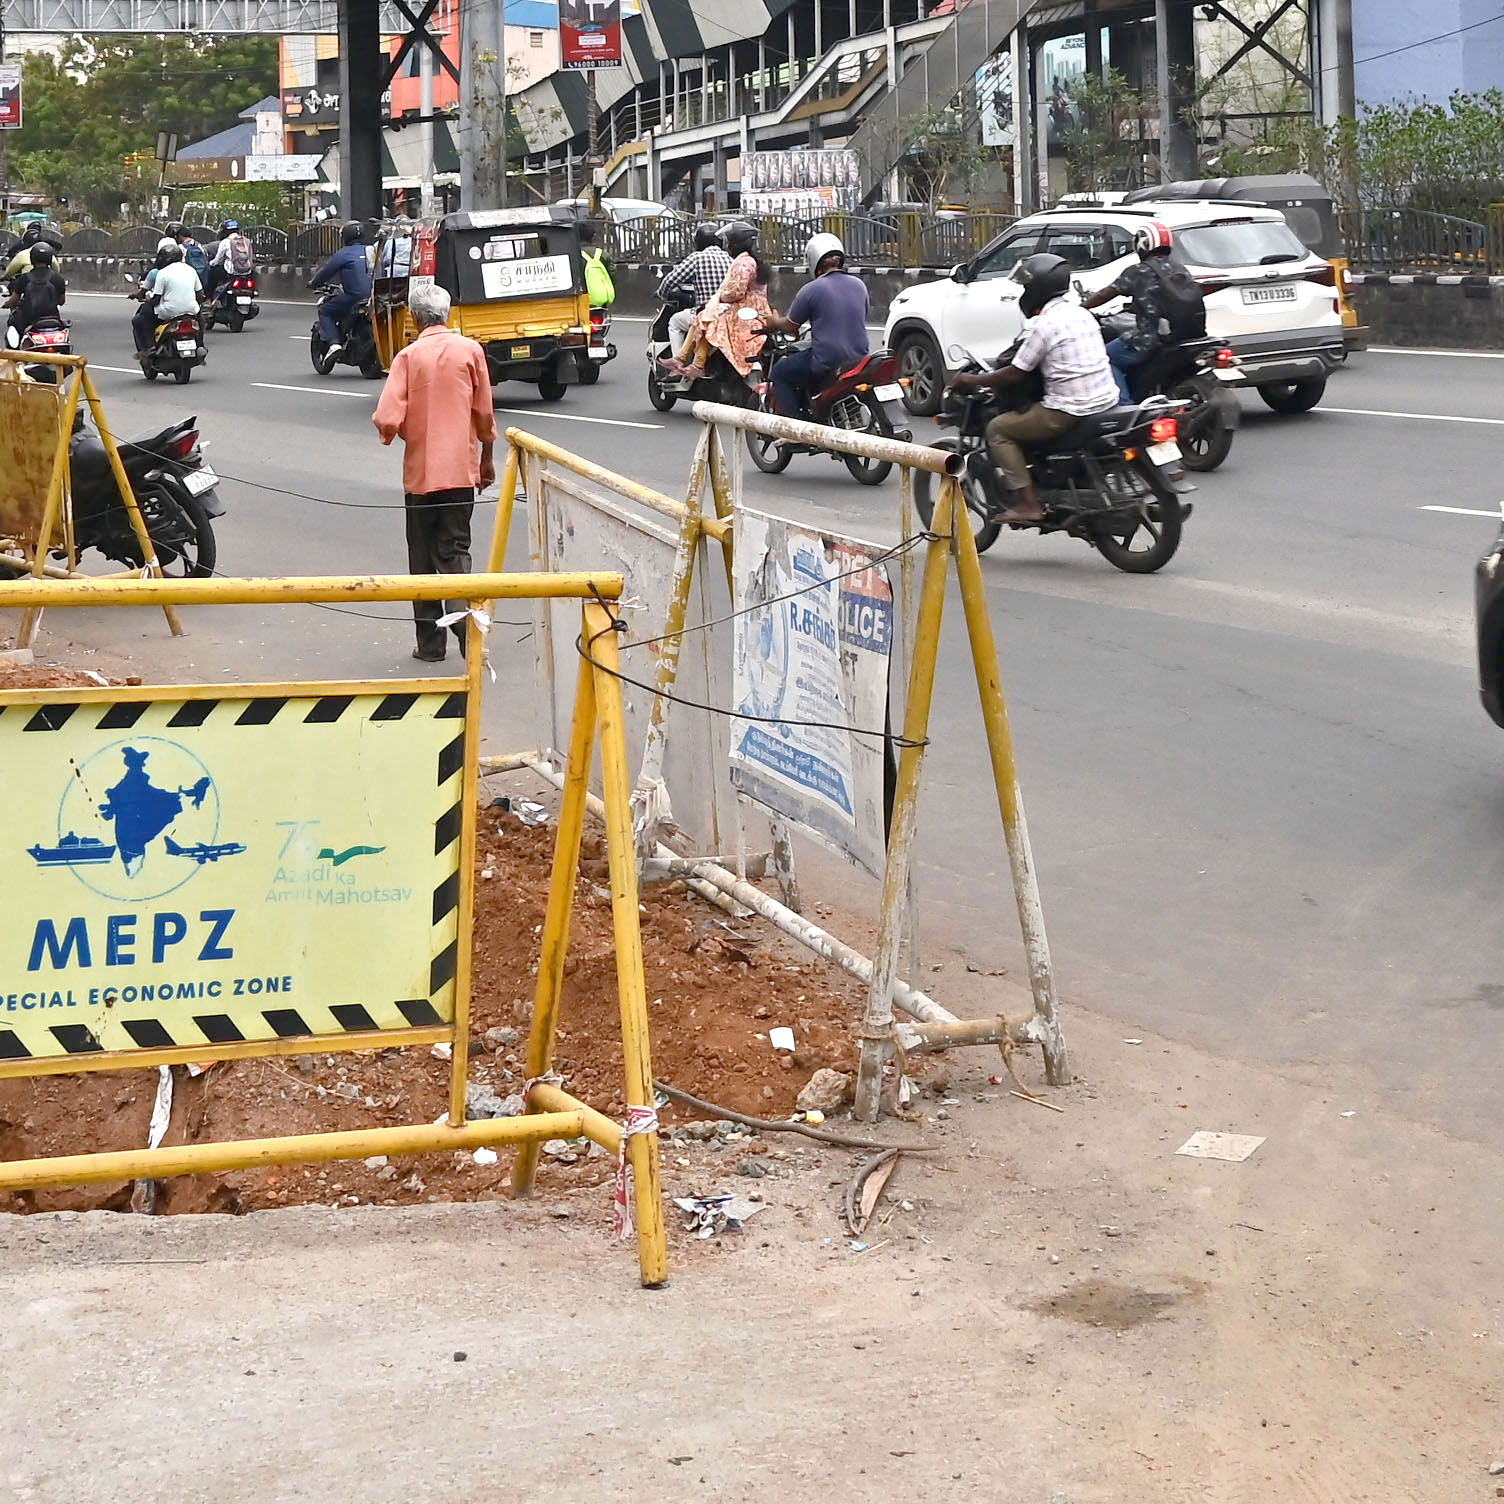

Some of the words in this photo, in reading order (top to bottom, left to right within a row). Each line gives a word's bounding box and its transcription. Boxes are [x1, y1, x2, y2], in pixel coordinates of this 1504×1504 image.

[838, 599, 886, 643] OLICE
[316, 887, 413, 905] Mahotsav
[26, 909, 236, 972] MEPZ
[88, 980, 223, 1006] ECONOMIC
[233, 975, 293, 995] ZONE
